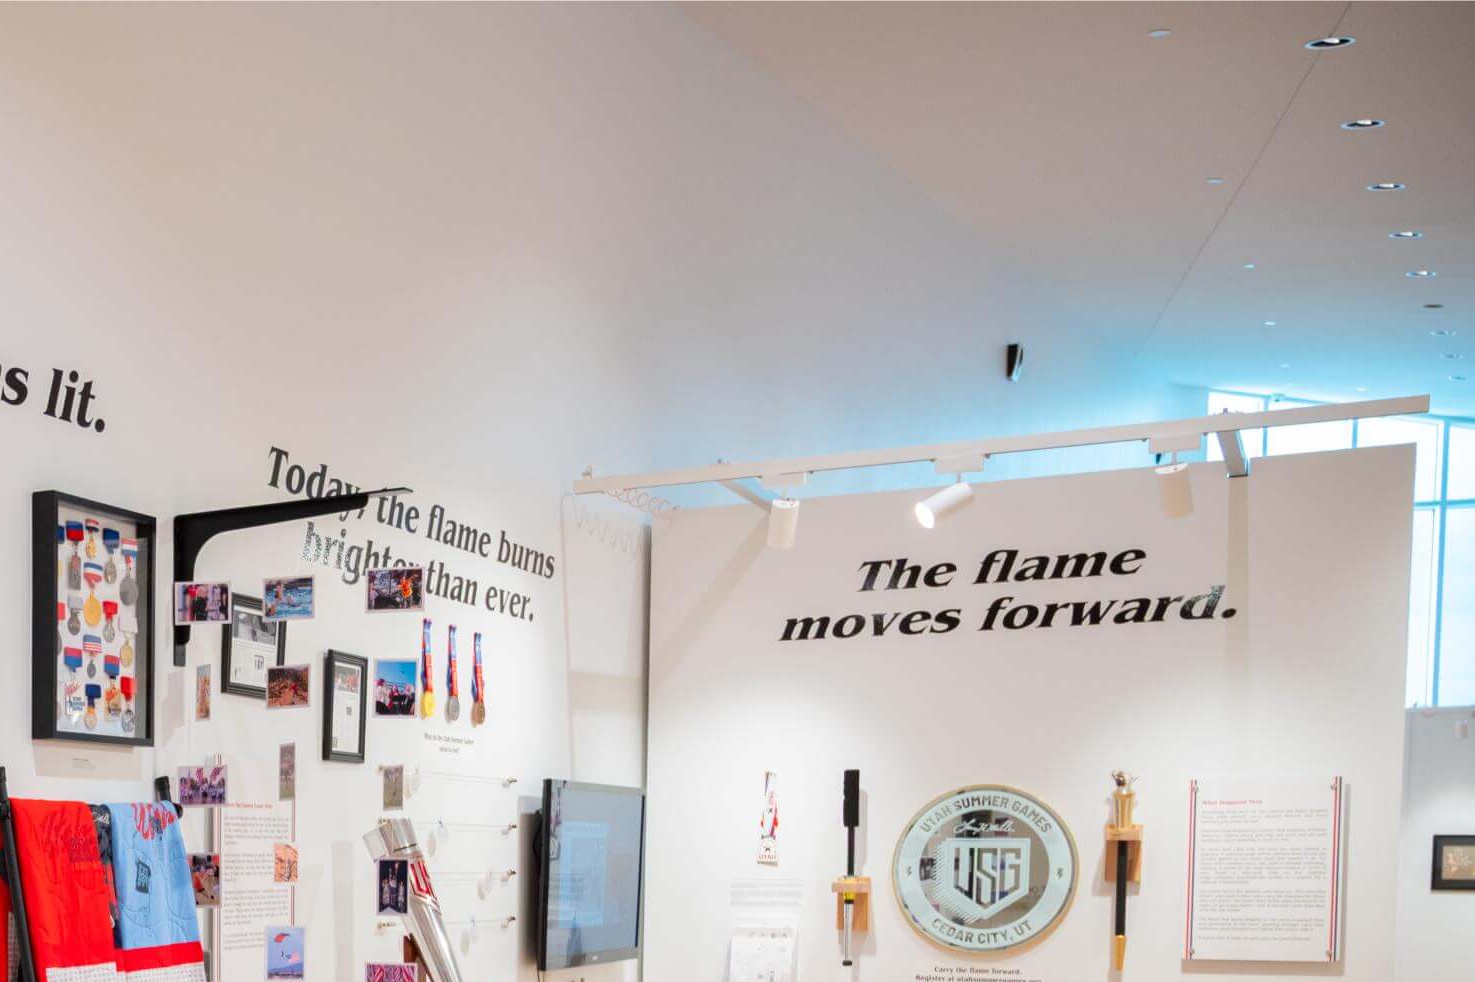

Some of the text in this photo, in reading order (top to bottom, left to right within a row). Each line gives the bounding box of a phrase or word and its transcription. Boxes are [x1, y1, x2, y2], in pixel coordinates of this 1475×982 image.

[42, 367, 107, 433] lit.
[376, 495, 420, 535] the
[425, 504, 492, 557] flame
[498, 530, 557, 581] burns
[425, 560, 478, 607] than
[485, 584, 535, 624] ever.
[856, 546, 1148, 593] The flame
[778, 584, 1239, 642] moves forward.
[919, 805, 952, 833] UTAH
[953, 795, 1009, 811] SUMMER
[1011, 799, 1053, 834] GAMES
[953, 847, 1022, 908] USG
[930, 917, 1034, 945] CEDAR CITY, UT
